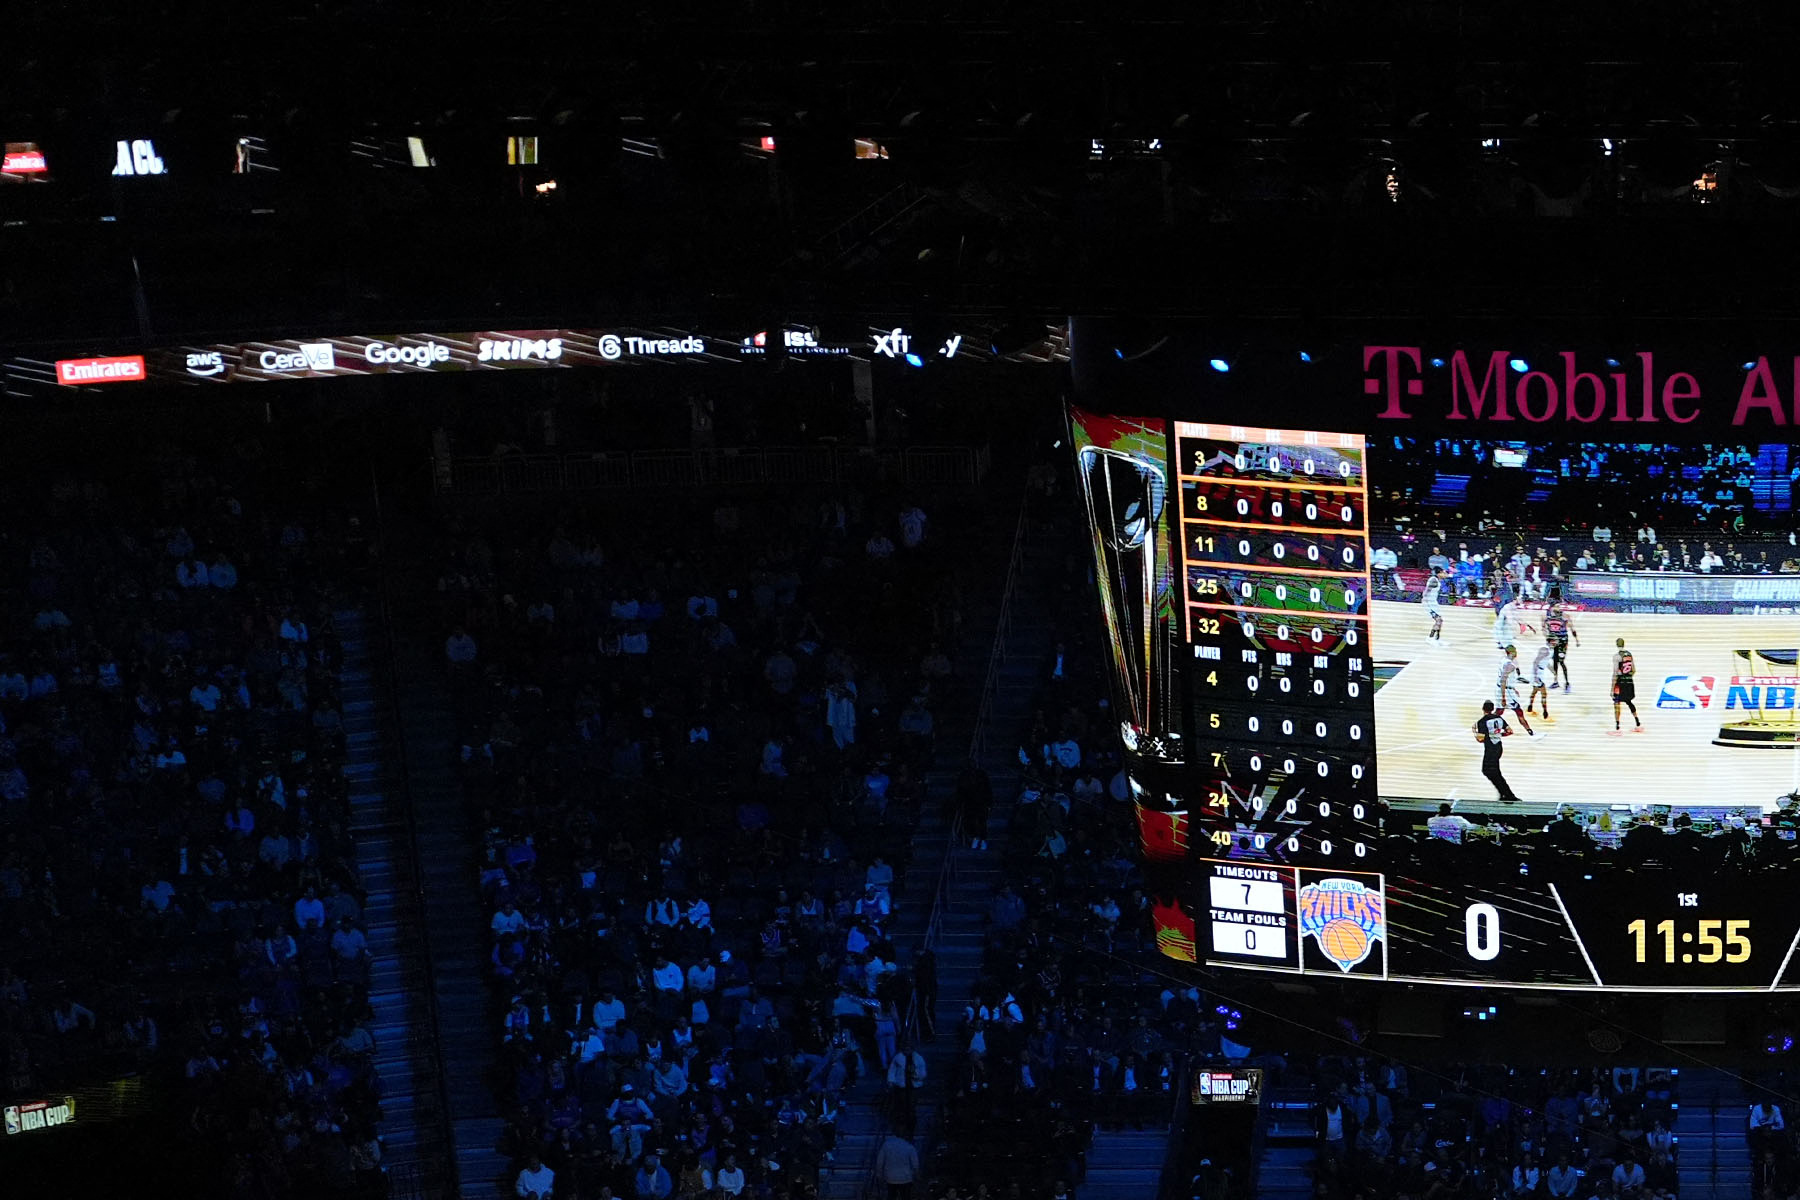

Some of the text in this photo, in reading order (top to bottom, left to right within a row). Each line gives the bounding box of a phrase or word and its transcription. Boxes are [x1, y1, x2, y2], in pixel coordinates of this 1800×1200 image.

[365, 343, 449, 368] Google
[477, 339, 562, 360] SKIMS
[624, 336, 704, 354] Threads
[186, 350, 222, 366] aws
[260, 349, 330, 370] CeraVe
[62, 361, 140, 380] Emirates
[1195, 451, 1350, 477] 3 0 0 0 0
[1197, 496, 1352, 522] 8 0 0 0 0
[1195, 536, 1354, 563] 11 0 0 0 0
[1197, 578, 1355, 605] 25 0 0 0 0
[1199, 619, 1357, 645] 32 0 0 0 0
[1195, 645, 1221, 660] PLAYER
[1206, 671, 1359, 697] 4 0 0 0 0
[1210, 714, 1220, 728] 5
[1211, 753, 1222, 767] 7
[1209, 793, 1229, 808] 24
[1211, 831, 1365, 857] 40 0 0 0 0
[1214, 866, 1278, 880] TIMEOUTS
[1240, 884, 1251, 905] 7
[1678, 893, 1698, 907] 1st
[1301, 889, 1382, 922] KNICKS
[1209, 910, 1287, 927] TEAM FOULS
[1245, 929, 1256, 950] 0
[1465, 903, 1500, 961] 0
[1627, 919, 1751, 963] 11:55
[1212, 1080, 1249, 1094] NBA CUP
[21, 1109, 46, 1131] NBA
[45, 1105, 69, 1126] CUP
